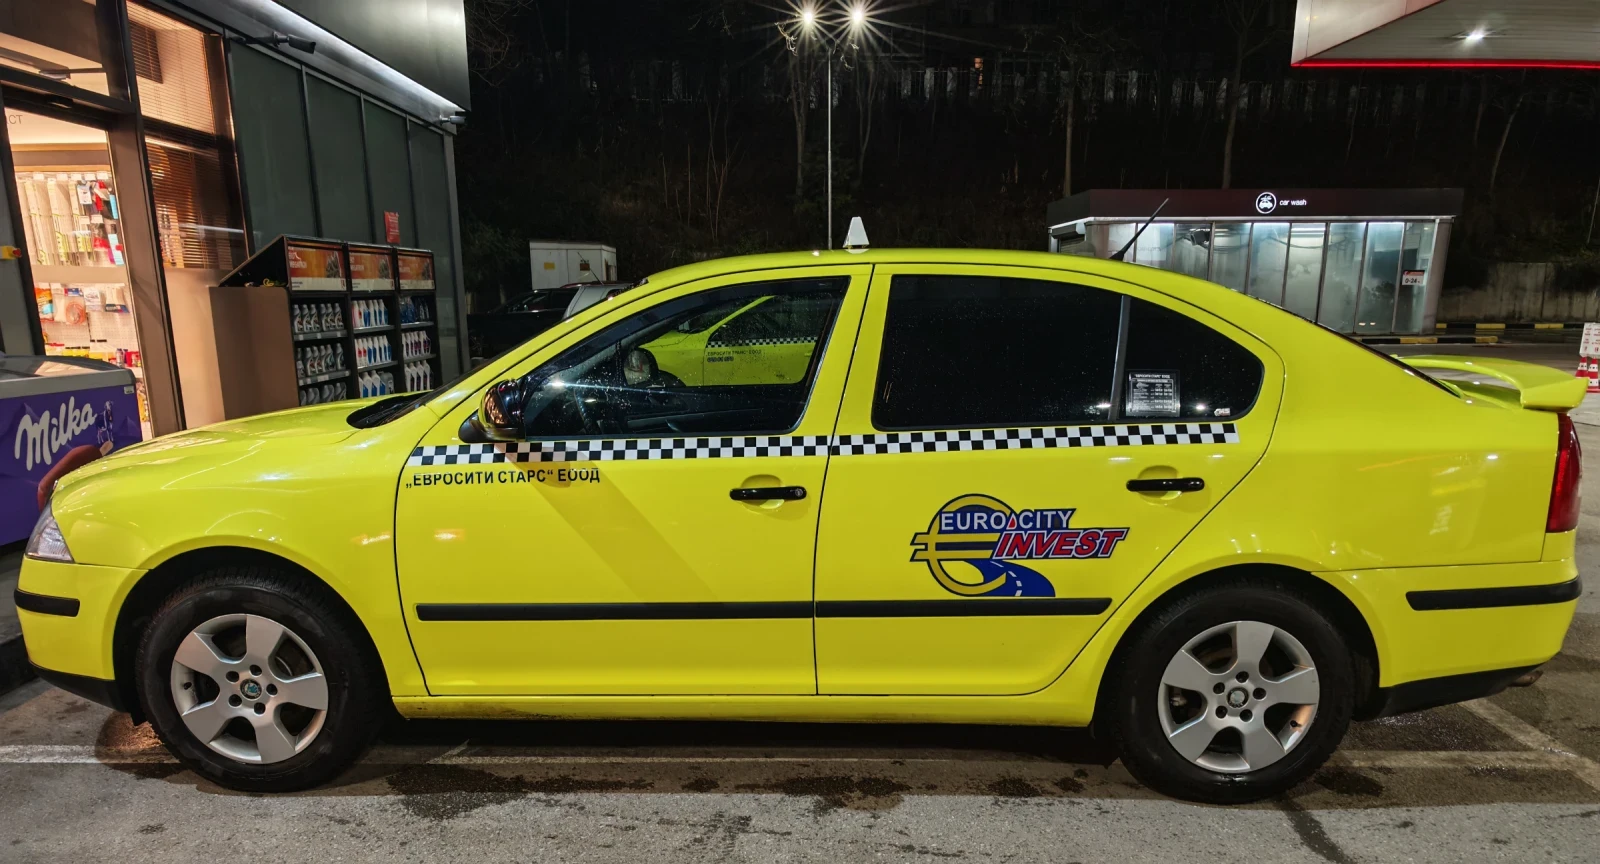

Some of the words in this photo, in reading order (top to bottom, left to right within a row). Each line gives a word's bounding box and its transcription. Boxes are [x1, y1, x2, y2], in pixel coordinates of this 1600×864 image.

[14, 396, 98, 471] Milka
[557, 467, 600, 482] ЕООД
[1019, 510, 1072, 529] CITY
[992, 529, 1130, 559] INVEST
